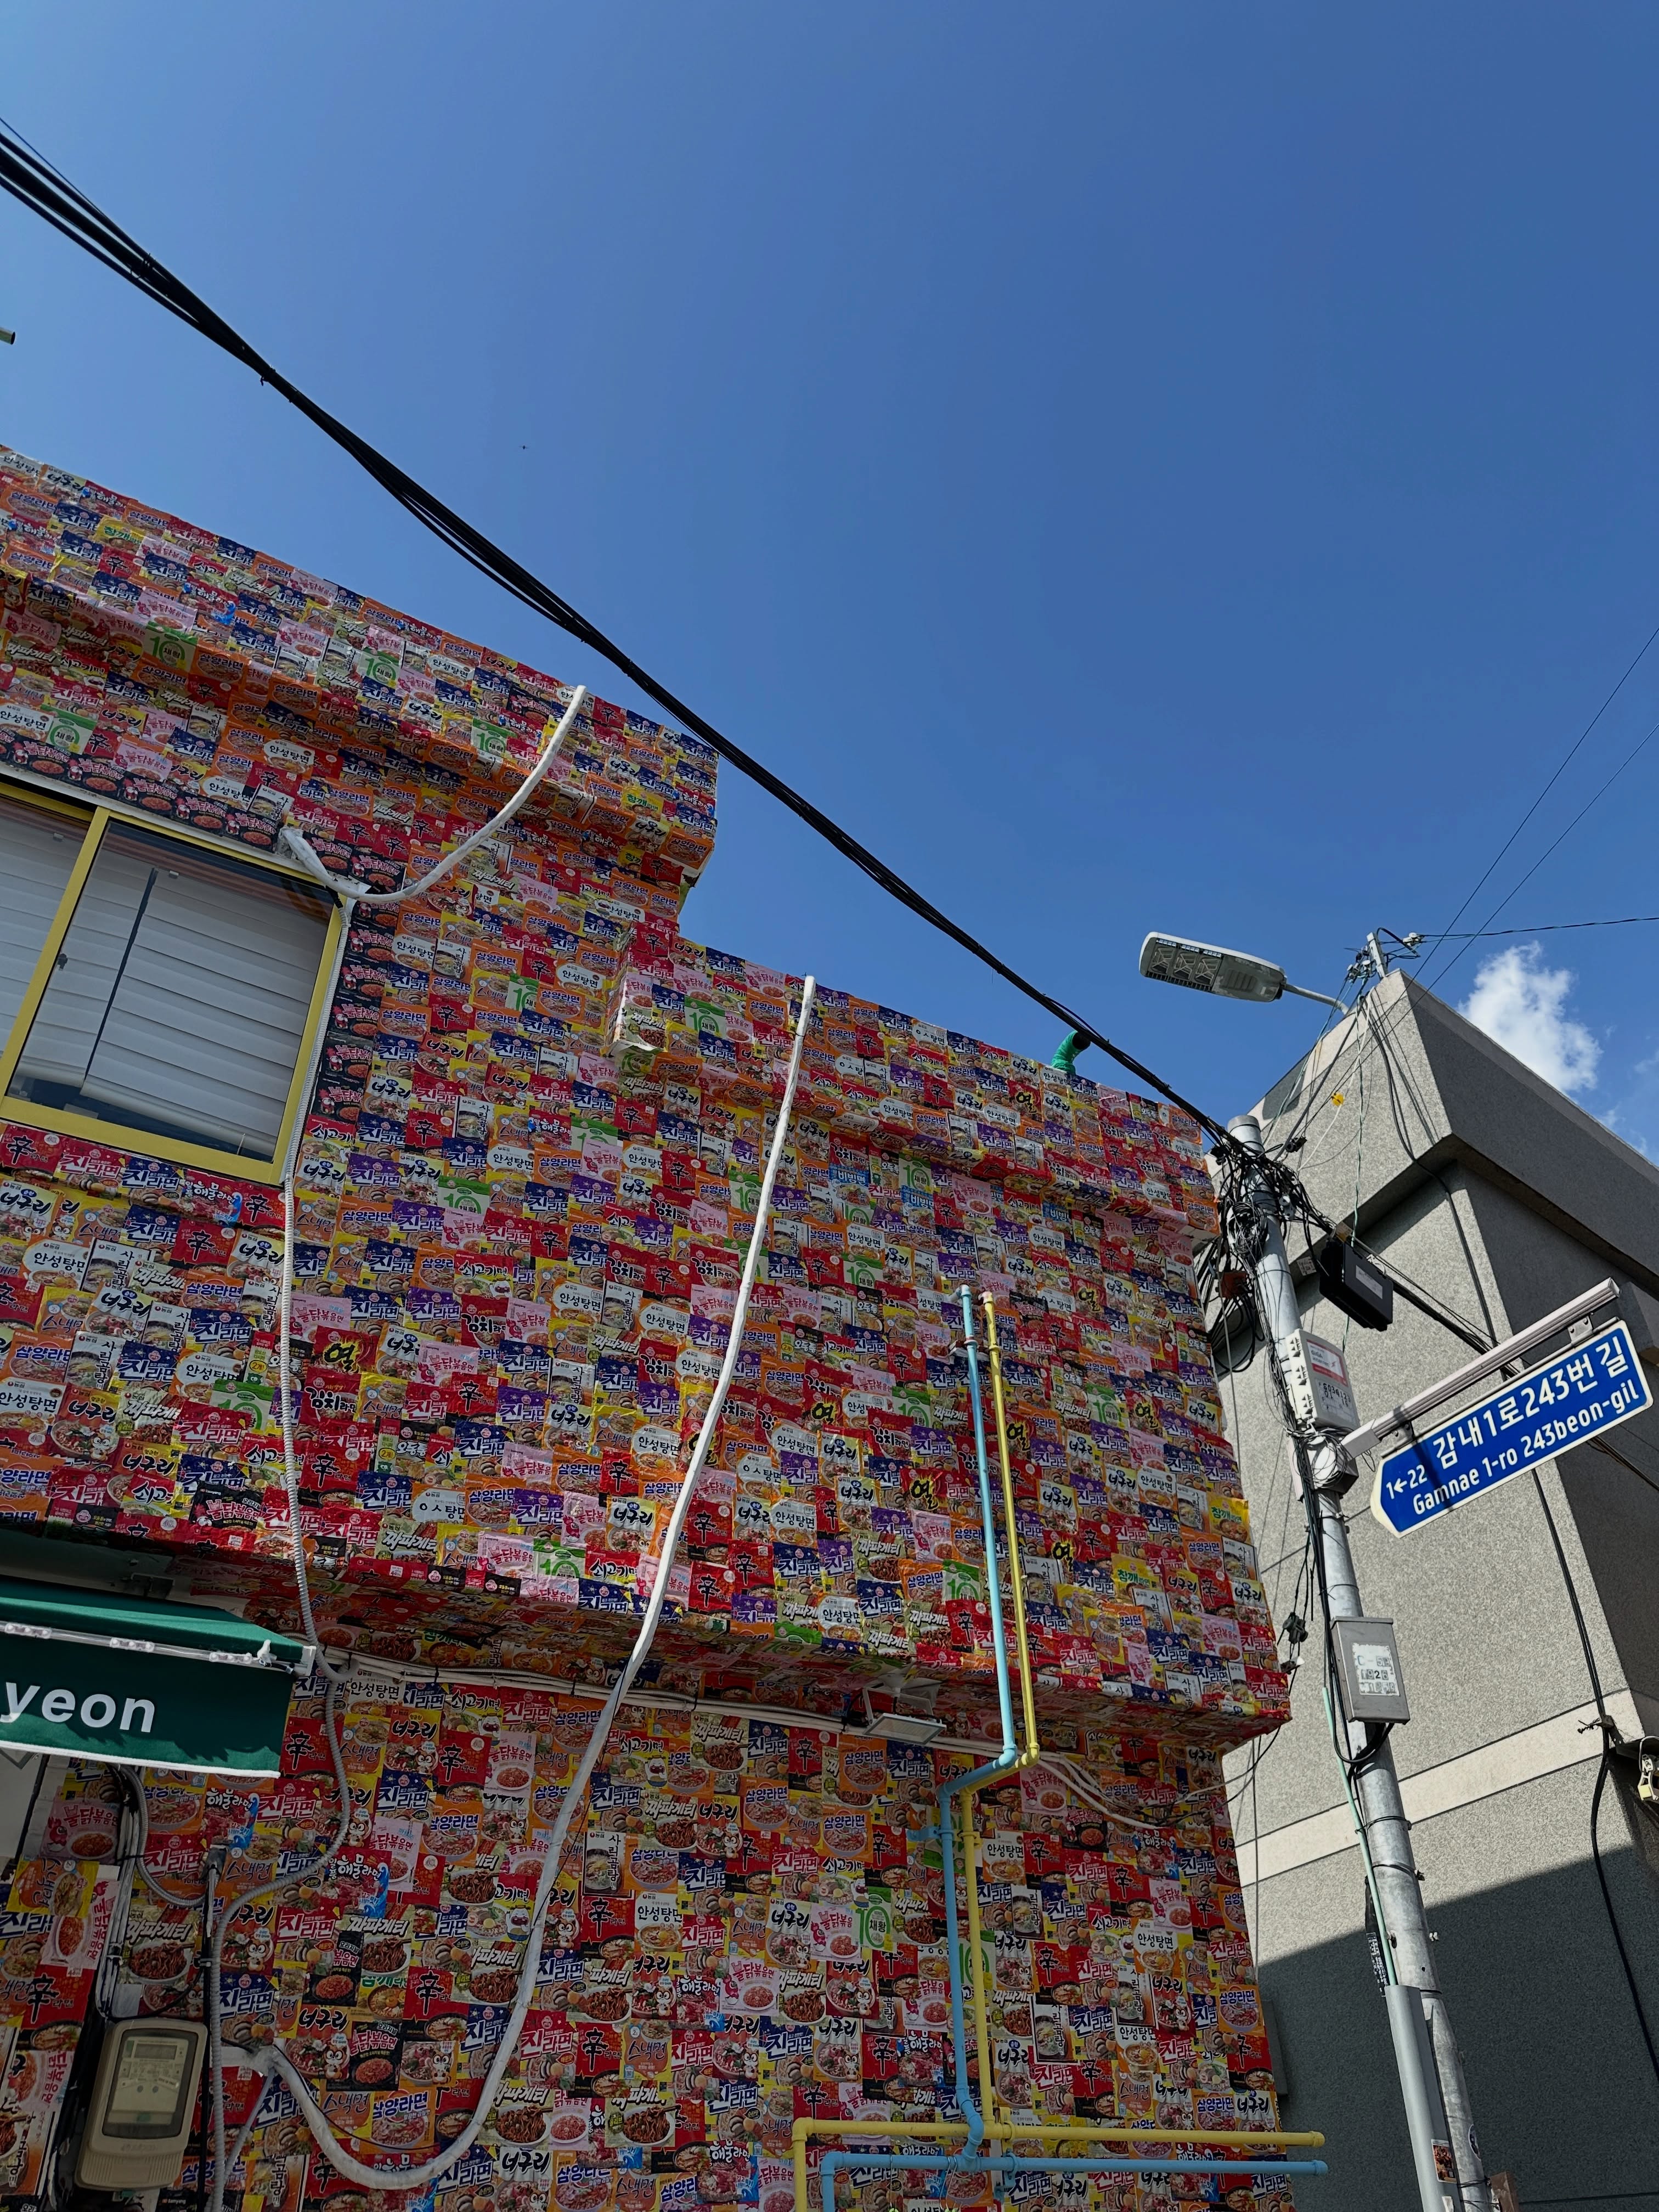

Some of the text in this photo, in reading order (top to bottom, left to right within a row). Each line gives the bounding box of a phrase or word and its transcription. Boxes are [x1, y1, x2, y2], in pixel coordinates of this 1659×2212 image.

[171, 526, 216, 548] 진라면
[231, 571, 275, 596] 짜파게티
[198, 653, 245, 672] 삼양라면
[432, 658, 469, 679] 안성탕면
[50, 685, 102, 708] 진라면
[104, 680, 151, 703] 진라면
[275, 683, 319, 699] 삼양라면
[101, 708, 144, 727] 너구리
[408, 701, 443, 721] 너구리
[269, 744, 311, 765] 안성탕면
[634, 821, 667, 838] 너구리
[675, 811, 714, 832] 진라면
[670, 837, 709, 854] 삼양라면
[471, 869, 516, 890] 짜파게티
[477, 951, 519, 967] 삼양라면
[709, 958, 746, 977] 진라면
[562, 969, 599, 988] 안성탕면
[382, 1009, 427, 1024] 삼양라면
[749, 1000, 785, 1016] 삼양라면
[425, 1039, 466, 1059] 너구리
[494, 1043, 538, 1062] 진라면
[371, 1080, 411, 1099] 너구리
[667, 1088, 701, 1107] 너구리
[704, 1104, 737, 1123] 너구리
[883, 1103, 914, 1121] 안성탕면
[986, 1109, 1017, 1126] 안성탕면
[58, 1154, 122, 1180] 진라면
[492, 1152, 535, 1171] 안성탕면
[122, 1169, 180, 1190] 진라면
[303, 1165, 346, 1183] 너구리
[350, 1166, 402, 1188] 진라면
[837, 1169, 867, 1186] 비빔면
[0, 1189, 53, 1215] 너구리
[574, 1188, 617, 1206] 진라면
[342, 1210, 393, 1224] 삼양라면
[485, 1224, 533, 1245] 진라면
[848, 1231, 882, 1248] 안성탕면
[1032, 1233, 1063, 1249] 안성탕면
[1008, 1260, 1035, 1277] 너구리
[186, 1282, 244, 1299] 삼양라면
[1107, 1279, 1132, 1296] 너구리
[100, 1291, 153, 1317] 너구리
[351, 1299, 400, 1321] 진라면
[560, 1293, 602, 1311] 안성탕면
[194, 1322, 253, 1344] 진라면
[591, 1334, 640, 1355] 짜파게티
[681, 1359, 721, 1379] 안성탕면
[766, 1371, 805, 1387] 삼양라면
[0, 1390, 59, 1414] 안성탕면
[1054, 1399, 1092, 1420] 짜파게티
[551, 1408, 591, 1426] 너구리
[1188, 1406, 1216, 1424] 너구리
[179, 1421, 242, 1445] 진라면
[823, 1442, 857, 1462] 너구리
[916, 1440, 952, 1457] 진라면
[1413, 1379, 1639, 1515] Gamnae 1-ro 243beon-gil
[122, 1454, 174, 1476] 너구리
[1141, 1475, 1173, 1493] 안성탕면
[1385, 1464, 1428, 1500] 1 22
[840, 1486, 874, 1502] 너구리
[1042, 1490, 1074, 1509] 너구리
[614, 1505, 653, 1526] 너구리
[857, 1538, 901, 1556] 짜파게티
[778, 1559, 820, 1579] 진라면
[1167, 1576, 1198, 1593] 너구리
[860, 1598, 902, 1619] 진라면
[1060, 1650, 1098, 1669] 진라면
[350, 1680, 400, 1701] 안성탕면
[1252, 1683, 1286, 1701] 진라면
[0, 1681, 155, 1733] yeon
[502, 1702, 552, 1726] 진라면
[391, 1719, 437, 1740] 너구리
[844, 1750, 884, 1765] 삼양라면
[256, 1795, 318, 1823] 진라면
[375, 1785, 431, 1814] 진라면
[592, 1786, 641, 1812] 진라면
[645, 1799, 697, 1819] 짜파게티
[699, 1802, 738, 1821] 너구리
[823, 1814, 866, 1830] 삼양라면
[986, 1842, 1025, 1859] 안성탕면
[144, 1849, 204, 1878] 진라면
[772, 1851, 819, 1876] 진라면
[771, 1910, 811, 1931] 너구리
[1047, 1900, 1086, 1924] 진라면
[277, 1908, 335, 1943] 진라면
[348, 1915, 411, 1937] 짜파게티
[1137, 1932, 1175, 1951] 안성탕면
[1076, 1960, 1114, 1984] 진라면
[1219, 1990, 1256, 2005] 삼양라면
[298, 2007, 349, 2031] 너구리
[1074, 2010, 1114, 2038] 진라면
[521, 2030, 574, 2061] 진라면
[766, 2031, 814, 2062] 진라면
[372, 2092, 428, 2119] 삼양라면
[1237, 2097, 1271, 2115] 너구리
[503, 2151, 551, 2173] 너구리
